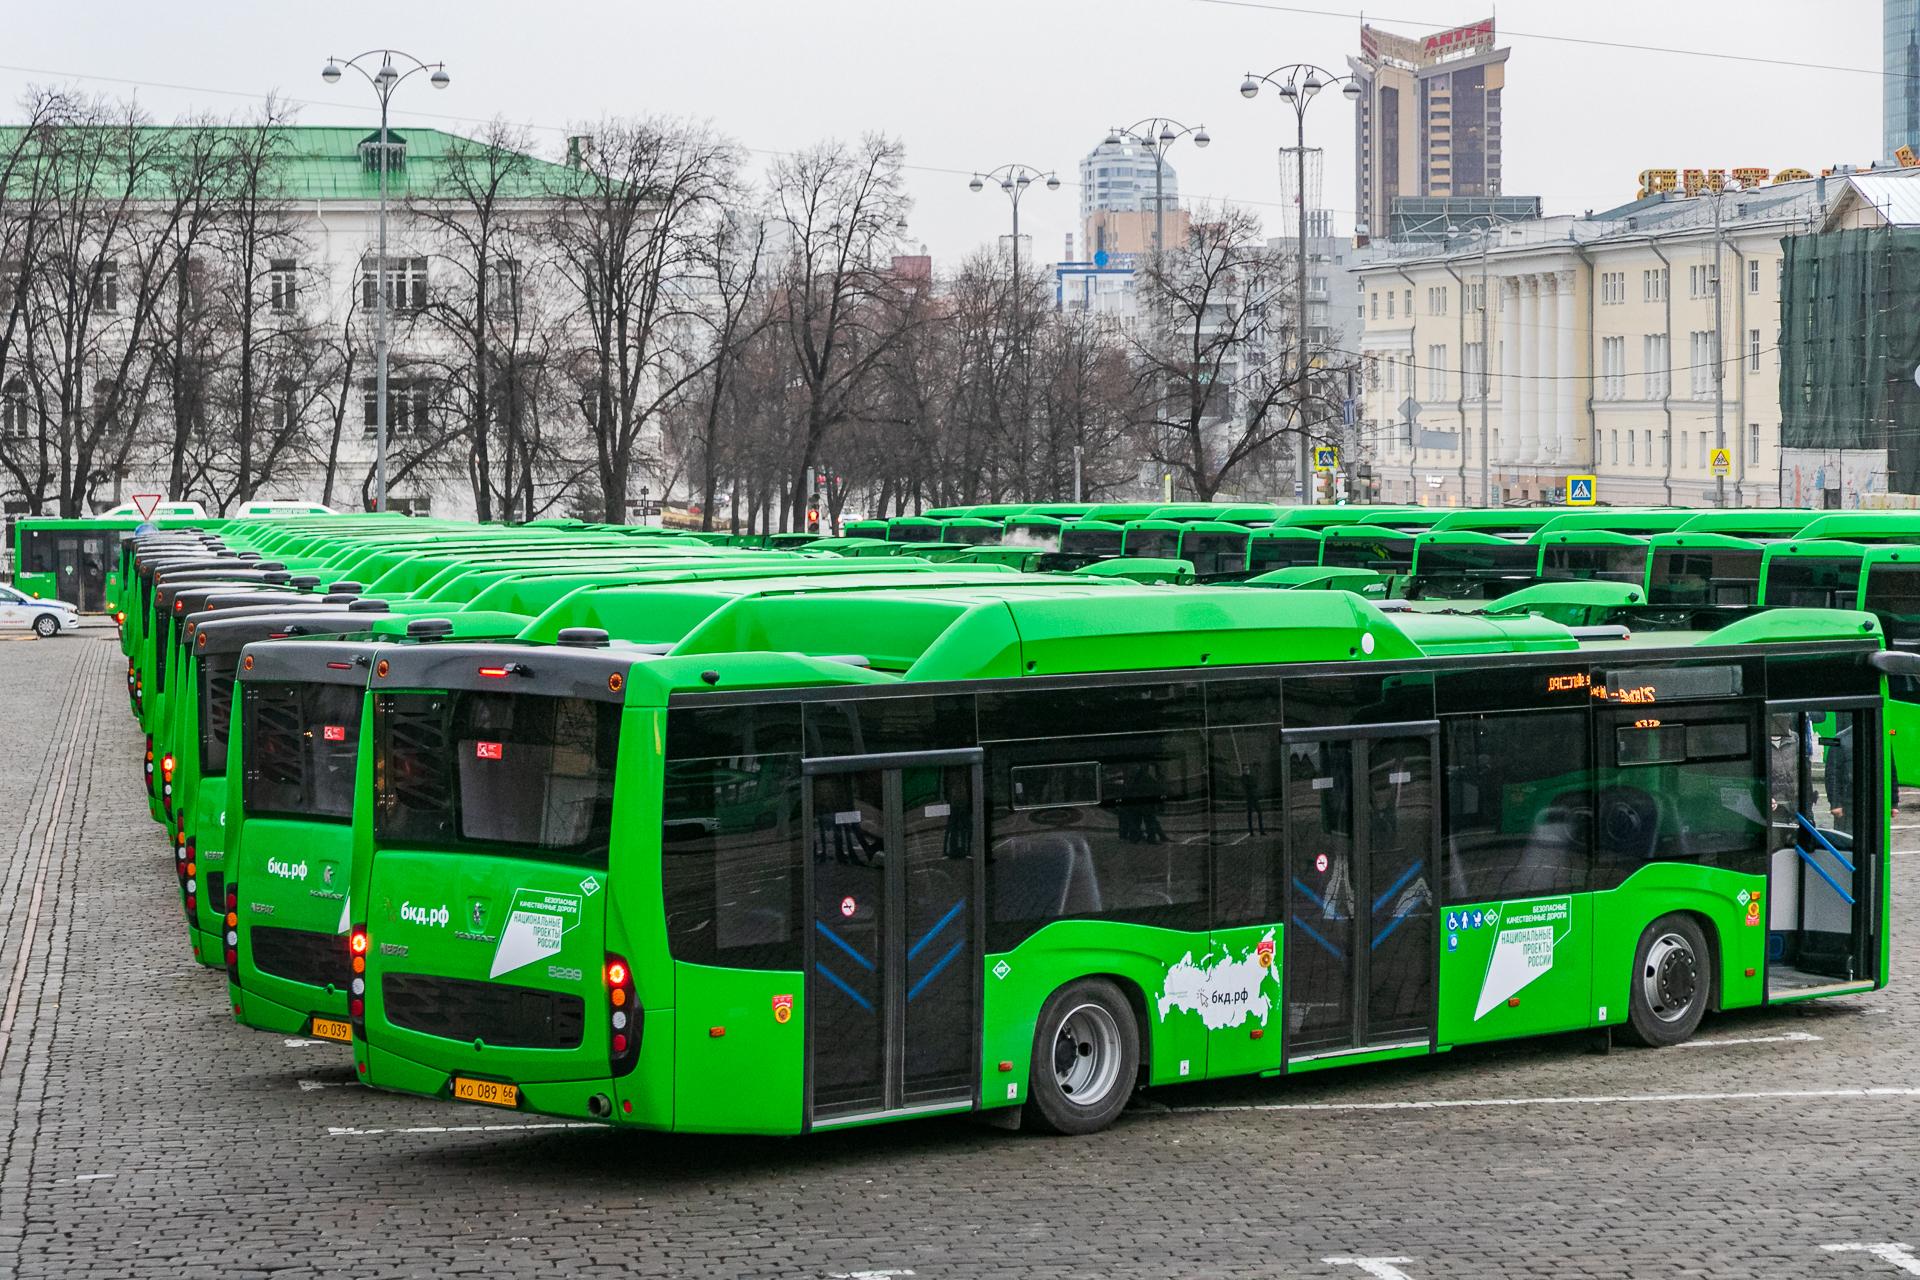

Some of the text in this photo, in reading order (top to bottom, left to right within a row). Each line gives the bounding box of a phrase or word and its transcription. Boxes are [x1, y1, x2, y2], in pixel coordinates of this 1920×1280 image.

[267, 856, 308, 880] бкд.рф
[400, 900, 450, 929] бкд.рф
[557, 904, 577, 914] ДОРОГИ
[1533, 903, 1567, 913] БЕЗОПАСНЫЕ
[513, 912, 561, 928] НАЦИОНАЛЬНЫЕ
[1507, 912, 1567, 924] КАЧЕСТВЕННЫЕ ДОРОГИ
[532, 925, 561, 939] ПРОЕКТЫ
[1502, 928, 1551, 944] НАЦИОНАЛЬНЫЕ
[537, 937, 560, 949] РОССИИ
[1523, 942, 1551, 955] ПРОЕКТЫ
[1528, 955, 1551, 967] РОССИИ
[547, 965, 583, 981] 5299
[1211, 987, 1249, 1004] бкд.рф
[330, 1023, 347, 1038] 039
[477, 1083, 498, 1100] 089
[502, 1086, 514, 1099] 66
